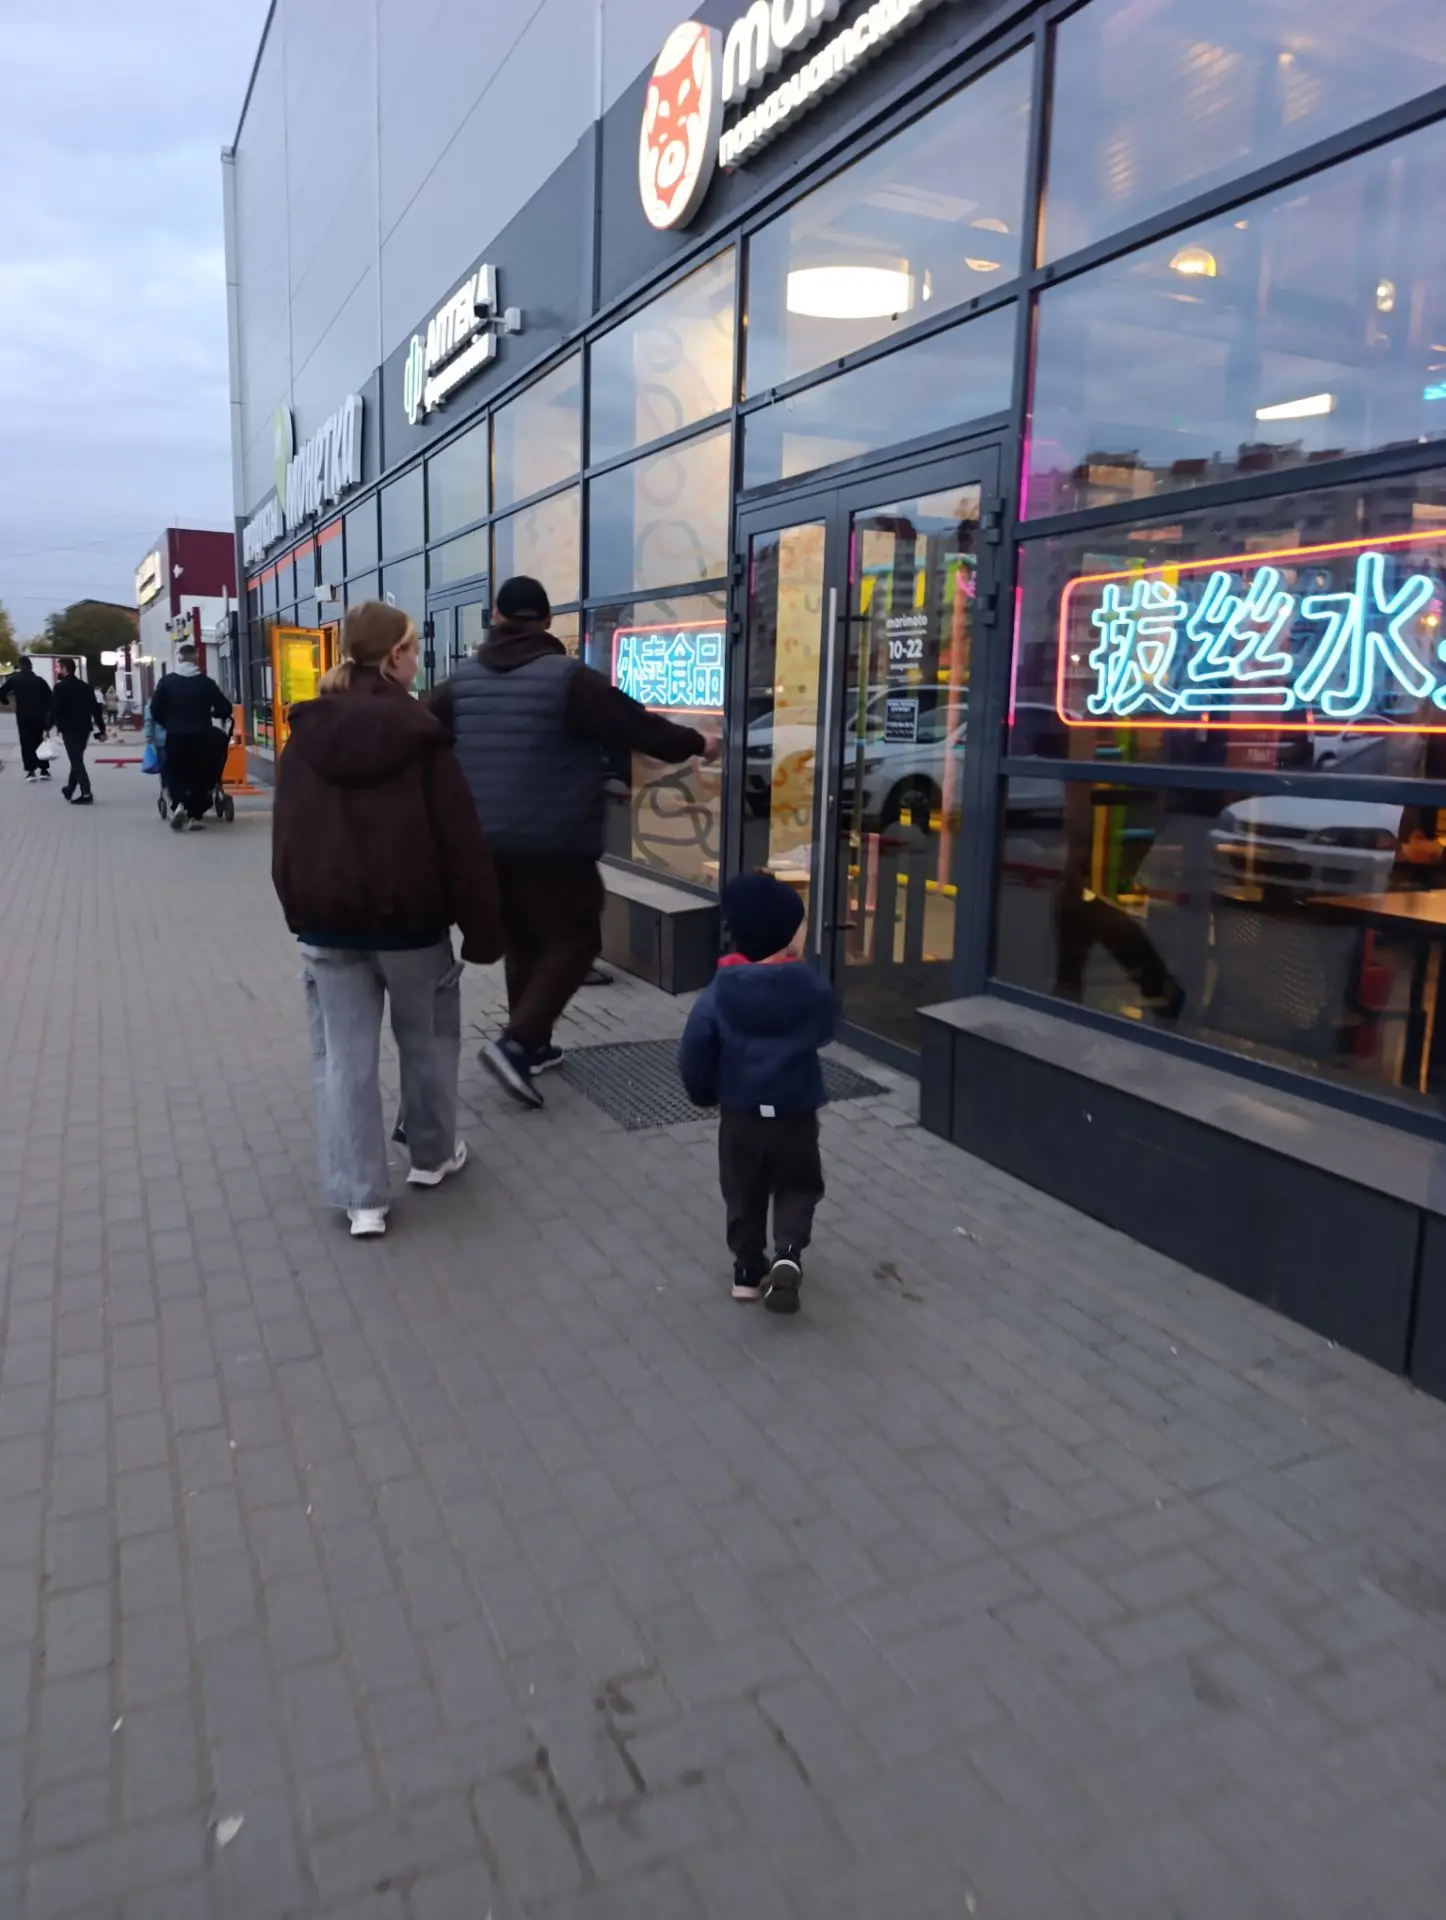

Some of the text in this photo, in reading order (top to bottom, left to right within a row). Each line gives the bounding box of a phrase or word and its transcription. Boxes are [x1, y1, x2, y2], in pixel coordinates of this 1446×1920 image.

[722, 0, 826, 102] ma
[889, 638, 923, 660] 10-22
[1087, 551, 1446, 717] 拔丝水
